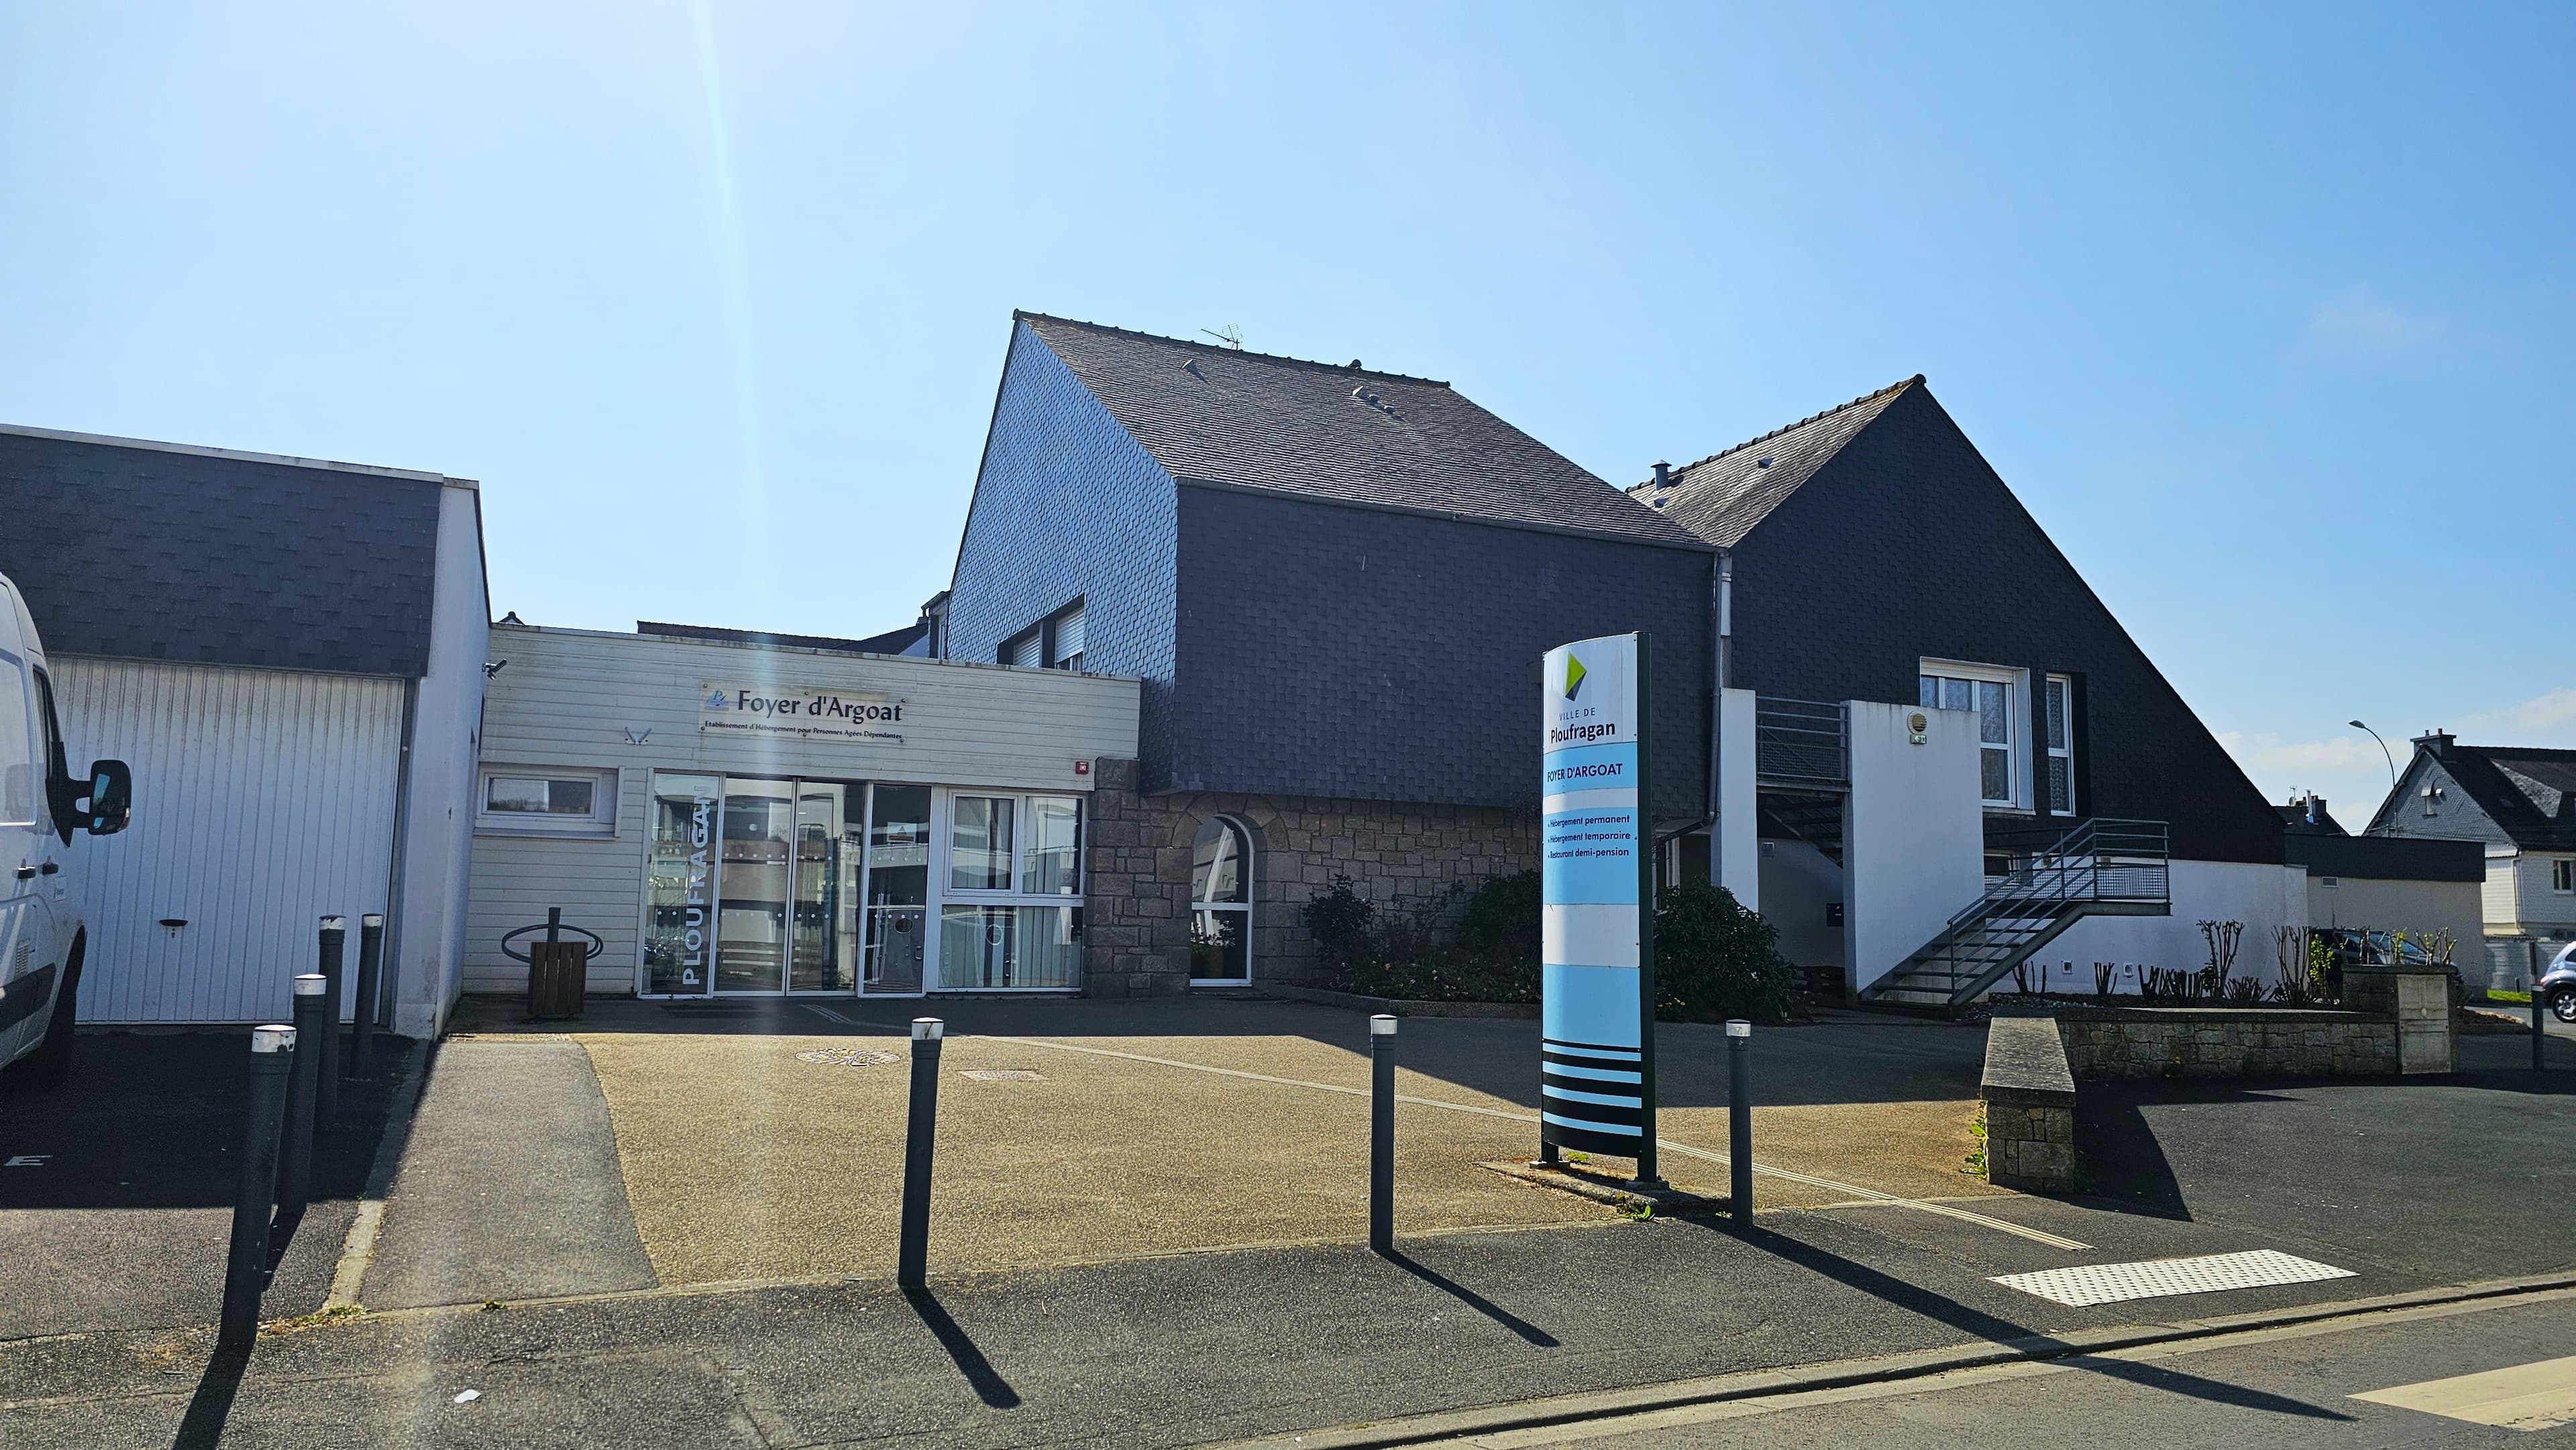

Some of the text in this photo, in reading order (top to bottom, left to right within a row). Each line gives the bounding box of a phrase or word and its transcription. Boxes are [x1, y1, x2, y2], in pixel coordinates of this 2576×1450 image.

[738, 690, 902, 724] Foyer d'Argoat
[1560, 708, 1595, 721] VILLE DE
[705, 720, 747, 730] Etablissement
[813, 728, 843, 736] Personnes
[1551, 724, 1615, 744] Ploufragan
[1548, 763, 1623, 783] FOYER D'ARGOAT
[1585, 816, 1629, 826] permanent
[1585, 831, 1631, 841] temporaire
[1575, 848, 1629, 858] demi-pension
[683, 785, 710, 985] PLOUFRAGAN
